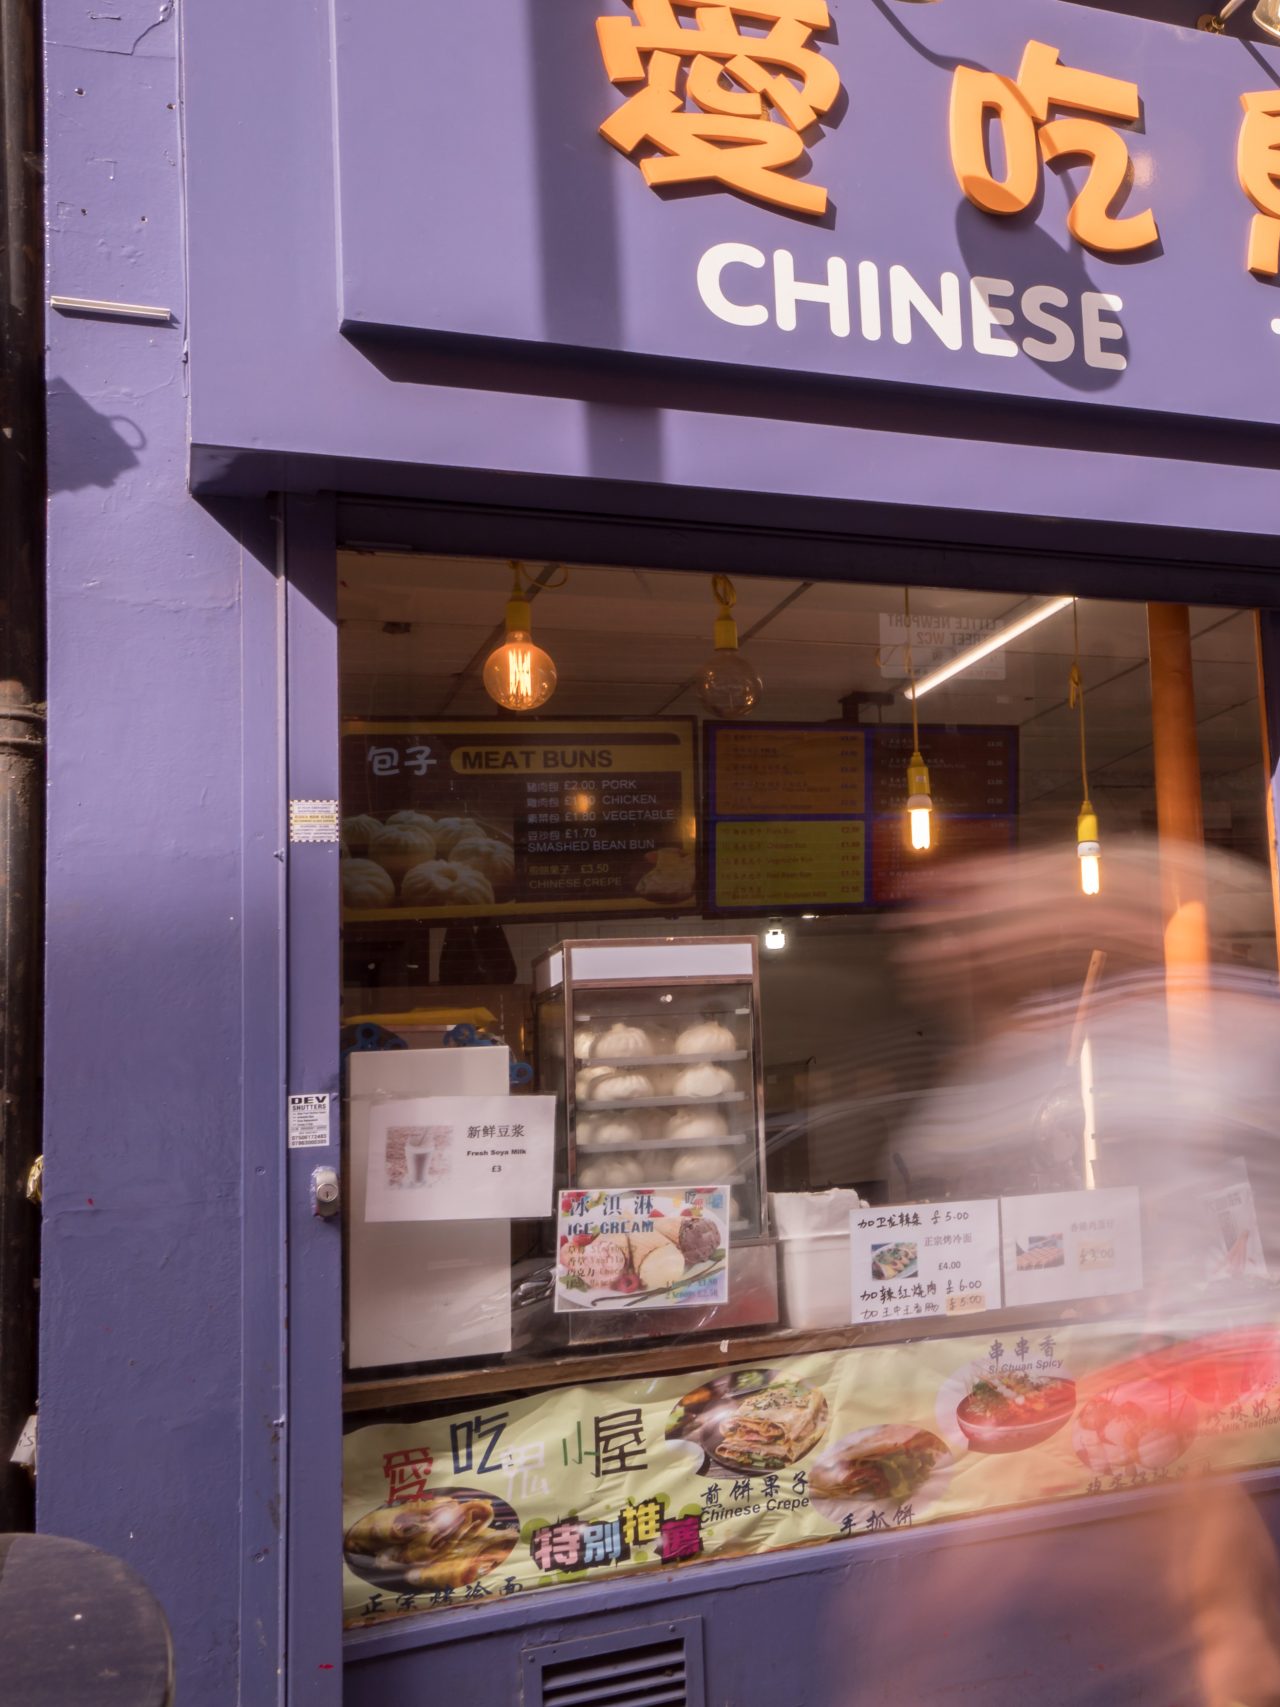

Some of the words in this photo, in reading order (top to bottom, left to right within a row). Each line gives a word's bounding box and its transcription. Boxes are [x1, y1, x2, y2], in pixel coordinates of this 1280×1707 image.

[697, 242, 1128, 371] CHINESE
[367, 746, 437, 776] 包子
[461, 751, 537, 770] MEAT
[542, 749, 614, 769] BUNS
[602, 780, 637, 790] PORK
[602, 794, 657, 805] CHICKEN
[602, 809, 675, 821] VEGETABLE
[565, 828, 597, 839] £1.70
[528, 841, 590, 853] SMASHED
[592, 840, 626, 851] BEAN
[629, 839, 655, 850] BUN
[291, 1095, 327, 1105] DEV
[467, 1124, 525, 1139] 新鲜豆浆
[491, 1164, 502, 1173] £3
[569, 1194, 654, 1217] 冰淇淋
[567, 1221, 594, 1236] ICE
[599, 1220, 654, 1235] CREAM
[938, 1260, 962, 1271] £4.00
[988, 1335, 1057, 1372] 串串香
[1001, 1362, 1033, 1373] Chuan
[1036, 1359, 1065, 1371] Spicy
[700, 1503, 771, 1524] Chinese
[776, 1497, 809, 1512] Crepe
